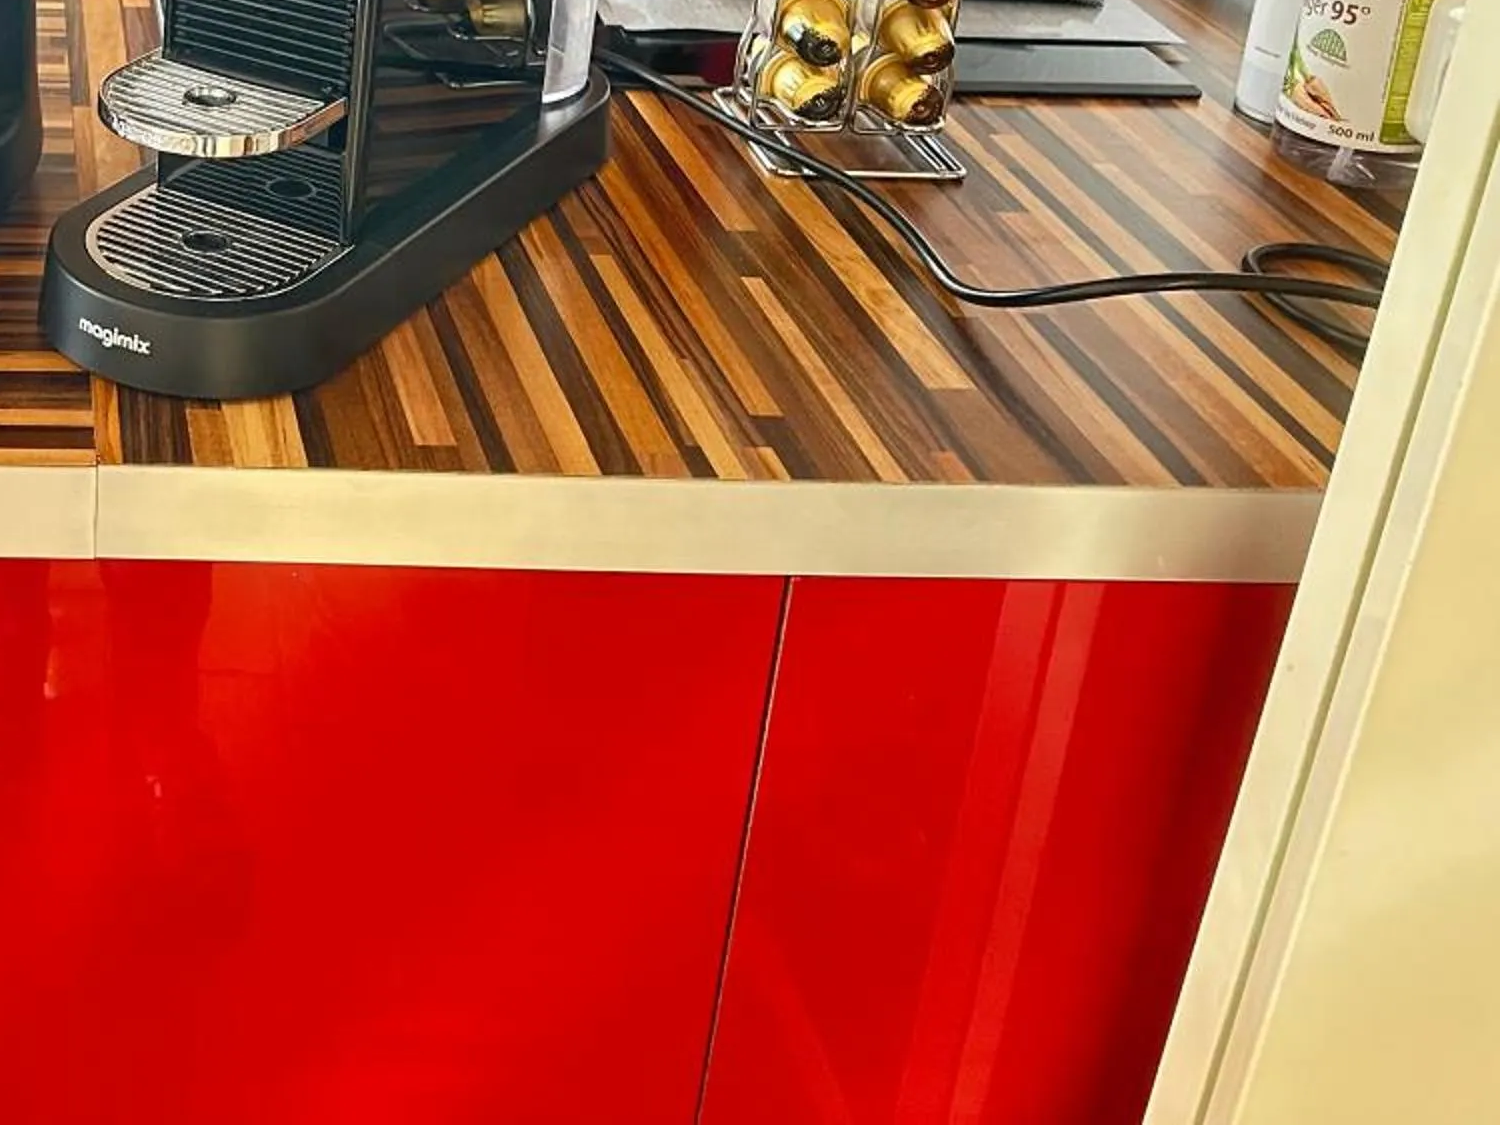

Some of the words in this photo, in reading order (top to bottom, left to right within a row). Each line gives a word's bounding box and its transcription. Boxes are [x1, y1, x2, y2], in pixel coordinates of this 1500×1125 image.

[1328, 124, 1353, 139] 500
[1356, 131, 1375, 142] ml
[79, 317, 151, 355] magimix
